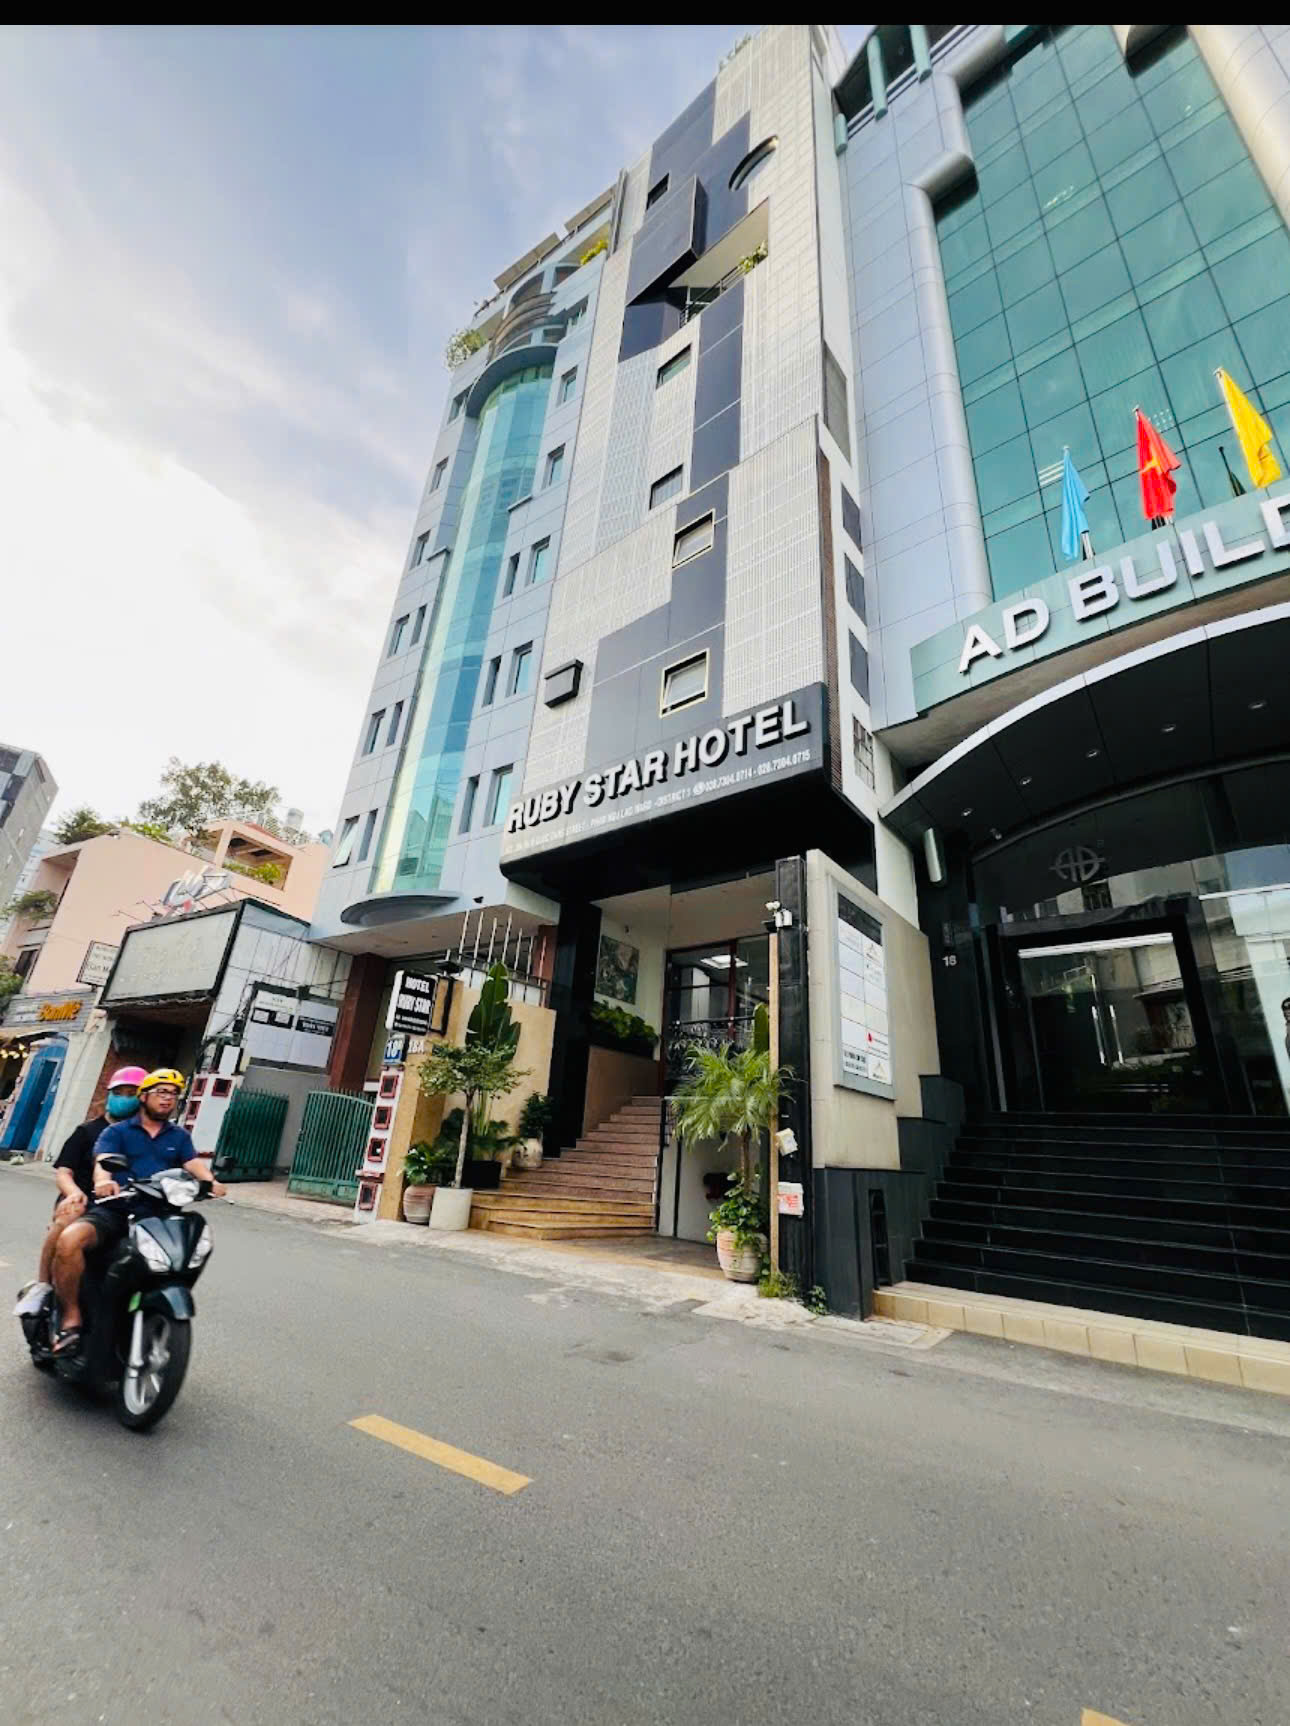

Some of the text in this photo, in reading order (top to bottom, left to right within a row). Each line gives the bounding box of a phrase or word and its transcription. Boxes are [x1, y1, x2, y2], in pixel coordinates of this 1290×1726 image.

[958, 597, 1050, 674] AD
[508, 700, 808, 831] RUBY STAR HOTEL
[405, 976, 429, 993] HOTEL
